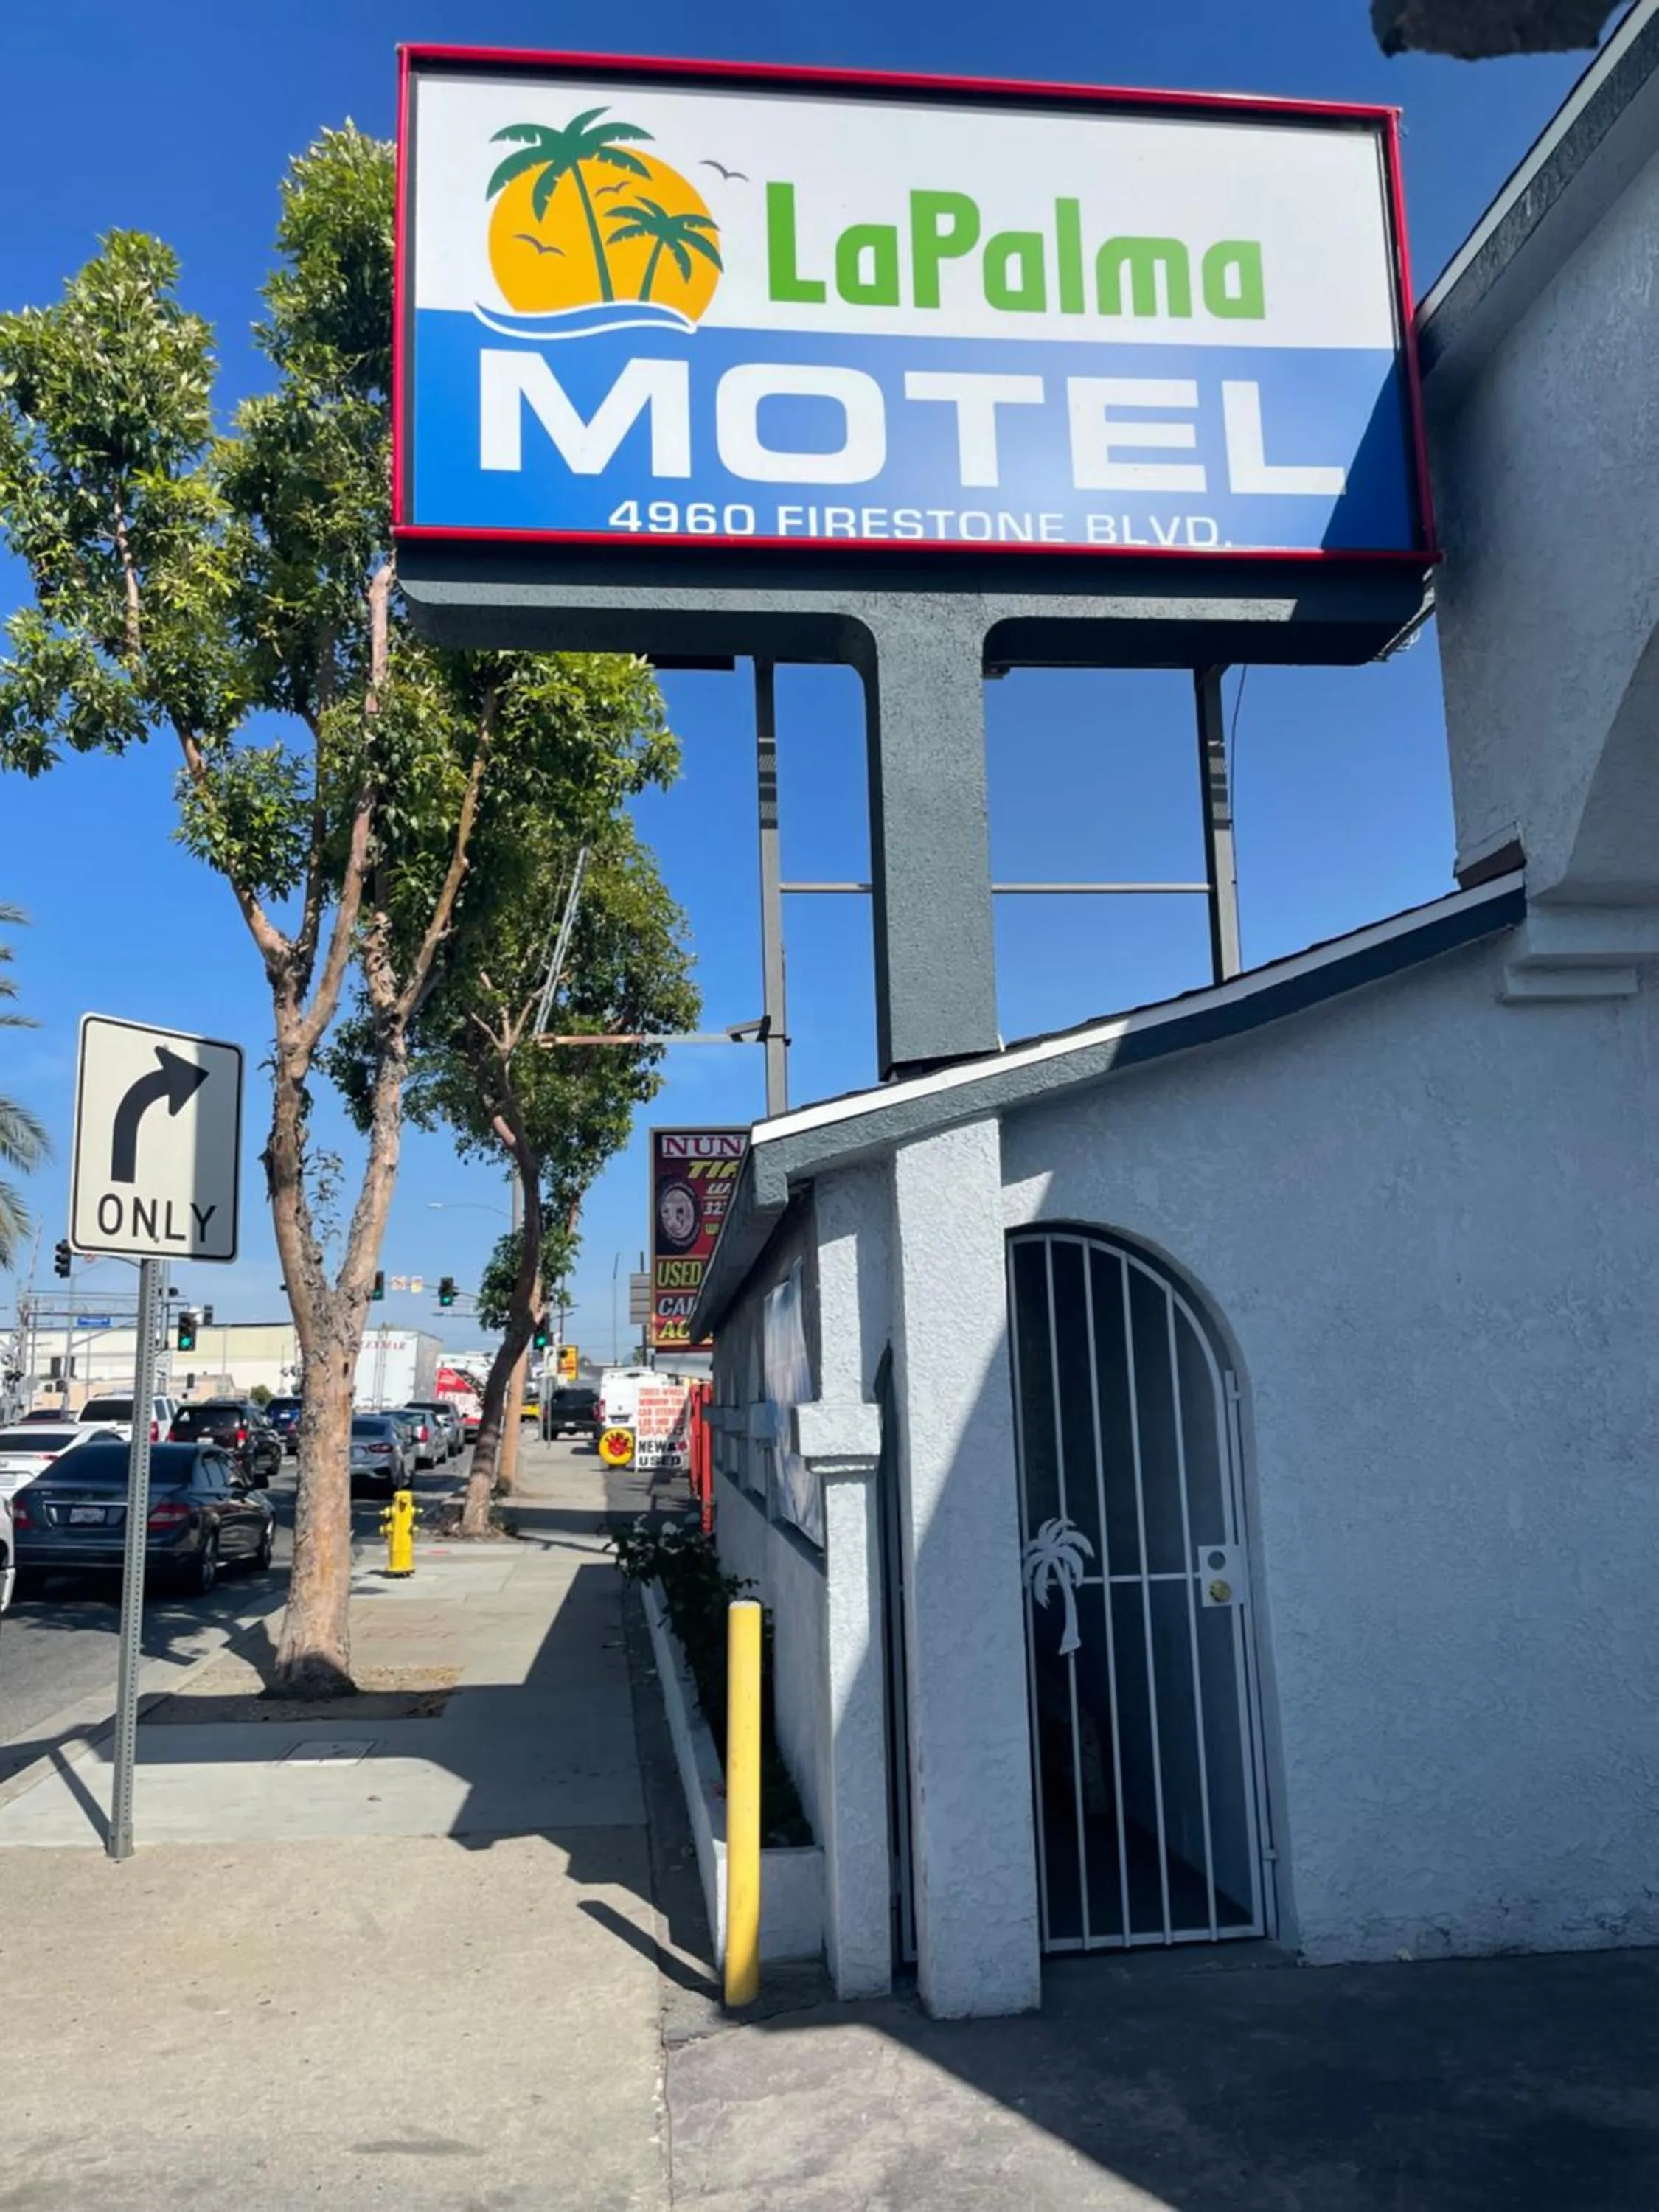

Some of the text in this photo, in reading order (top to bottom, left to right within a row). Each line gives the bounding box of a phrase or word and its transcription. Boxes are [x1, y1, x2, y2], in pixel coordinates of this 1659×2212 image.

[765, 181, 1266, 320] LaPalma
[479, 349, 1347, 496] MOTEL
[608, 500, 1232, 549] 4960 FIRESTONE BLVD.
[97, 1192, 217, 1243] ONLY
[658, 1261, 703, 1287] USED
[639, 1440, 666, 1453] NEW
[639, 1455, 681, 1467] USED
